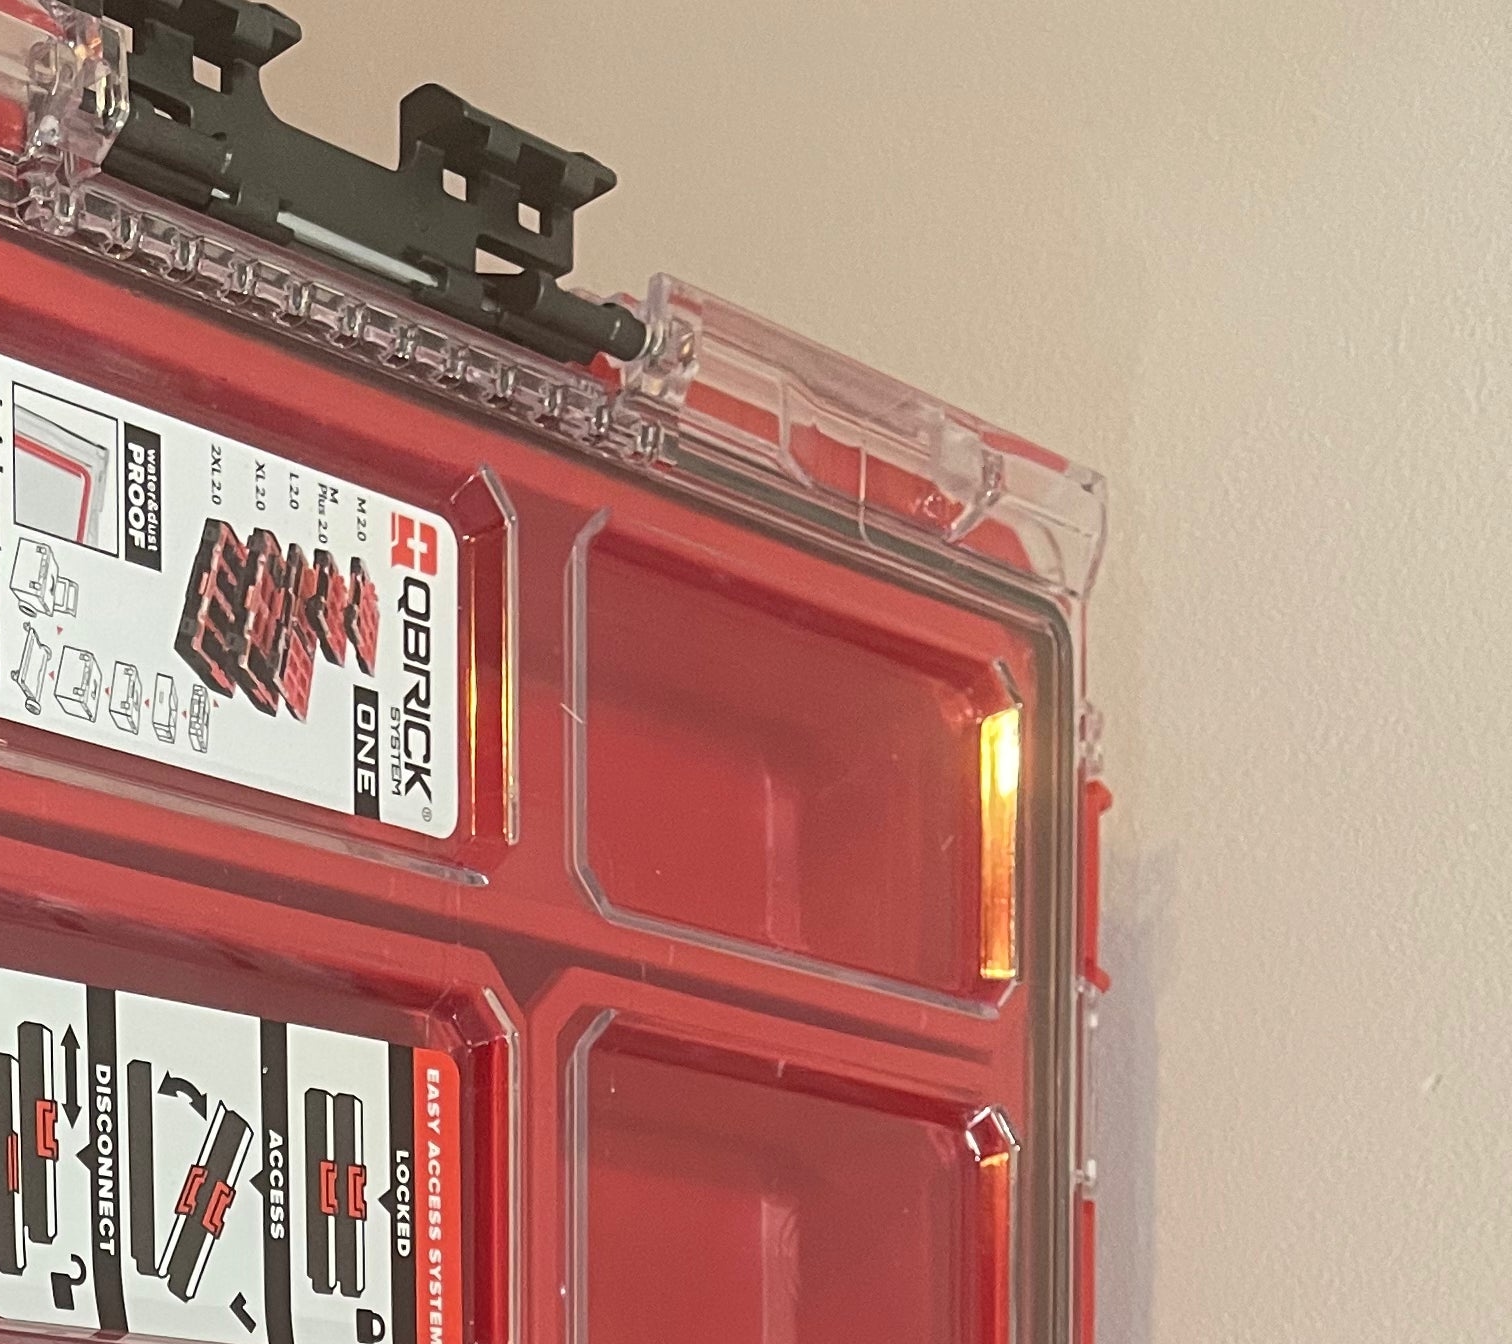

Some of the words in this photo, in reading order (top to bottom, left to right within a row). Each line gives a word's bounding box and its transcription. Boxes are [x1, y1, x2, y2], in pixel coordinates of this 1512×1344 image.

[212, 445, 222, 476] 2XL
[256, 460, 266, 482] XL
[128, 442, 145, 549] PROOF
[146, 448, 159, 552] water&dust
[212, 480, 222, 505] 2.0
[256, 485, 266, 511] 2.0
[290, 485, 299, 510] 2.0
[318, 483, 327, 515] Plus
[330, 487, 339, 504] M
[357, 496, 366, 513] M
[318, 519, 328, 544] 2.0
[357, 516, 367, 542] 2.0
[398, 576, 432, 803] QBRICK
[357, 703, 376, 797] ONE
[391, 707, 402, 795] SYSTEM
[427, 1068, 441, 1135] EASY
[96, 1063, 115, 1255] DISCONNECT
[269, 1129, 285, 1239] ACCESS
[396, 1150, 411, 1257] LOCKED
[428, 1141, 442, 1241] ACCESS
